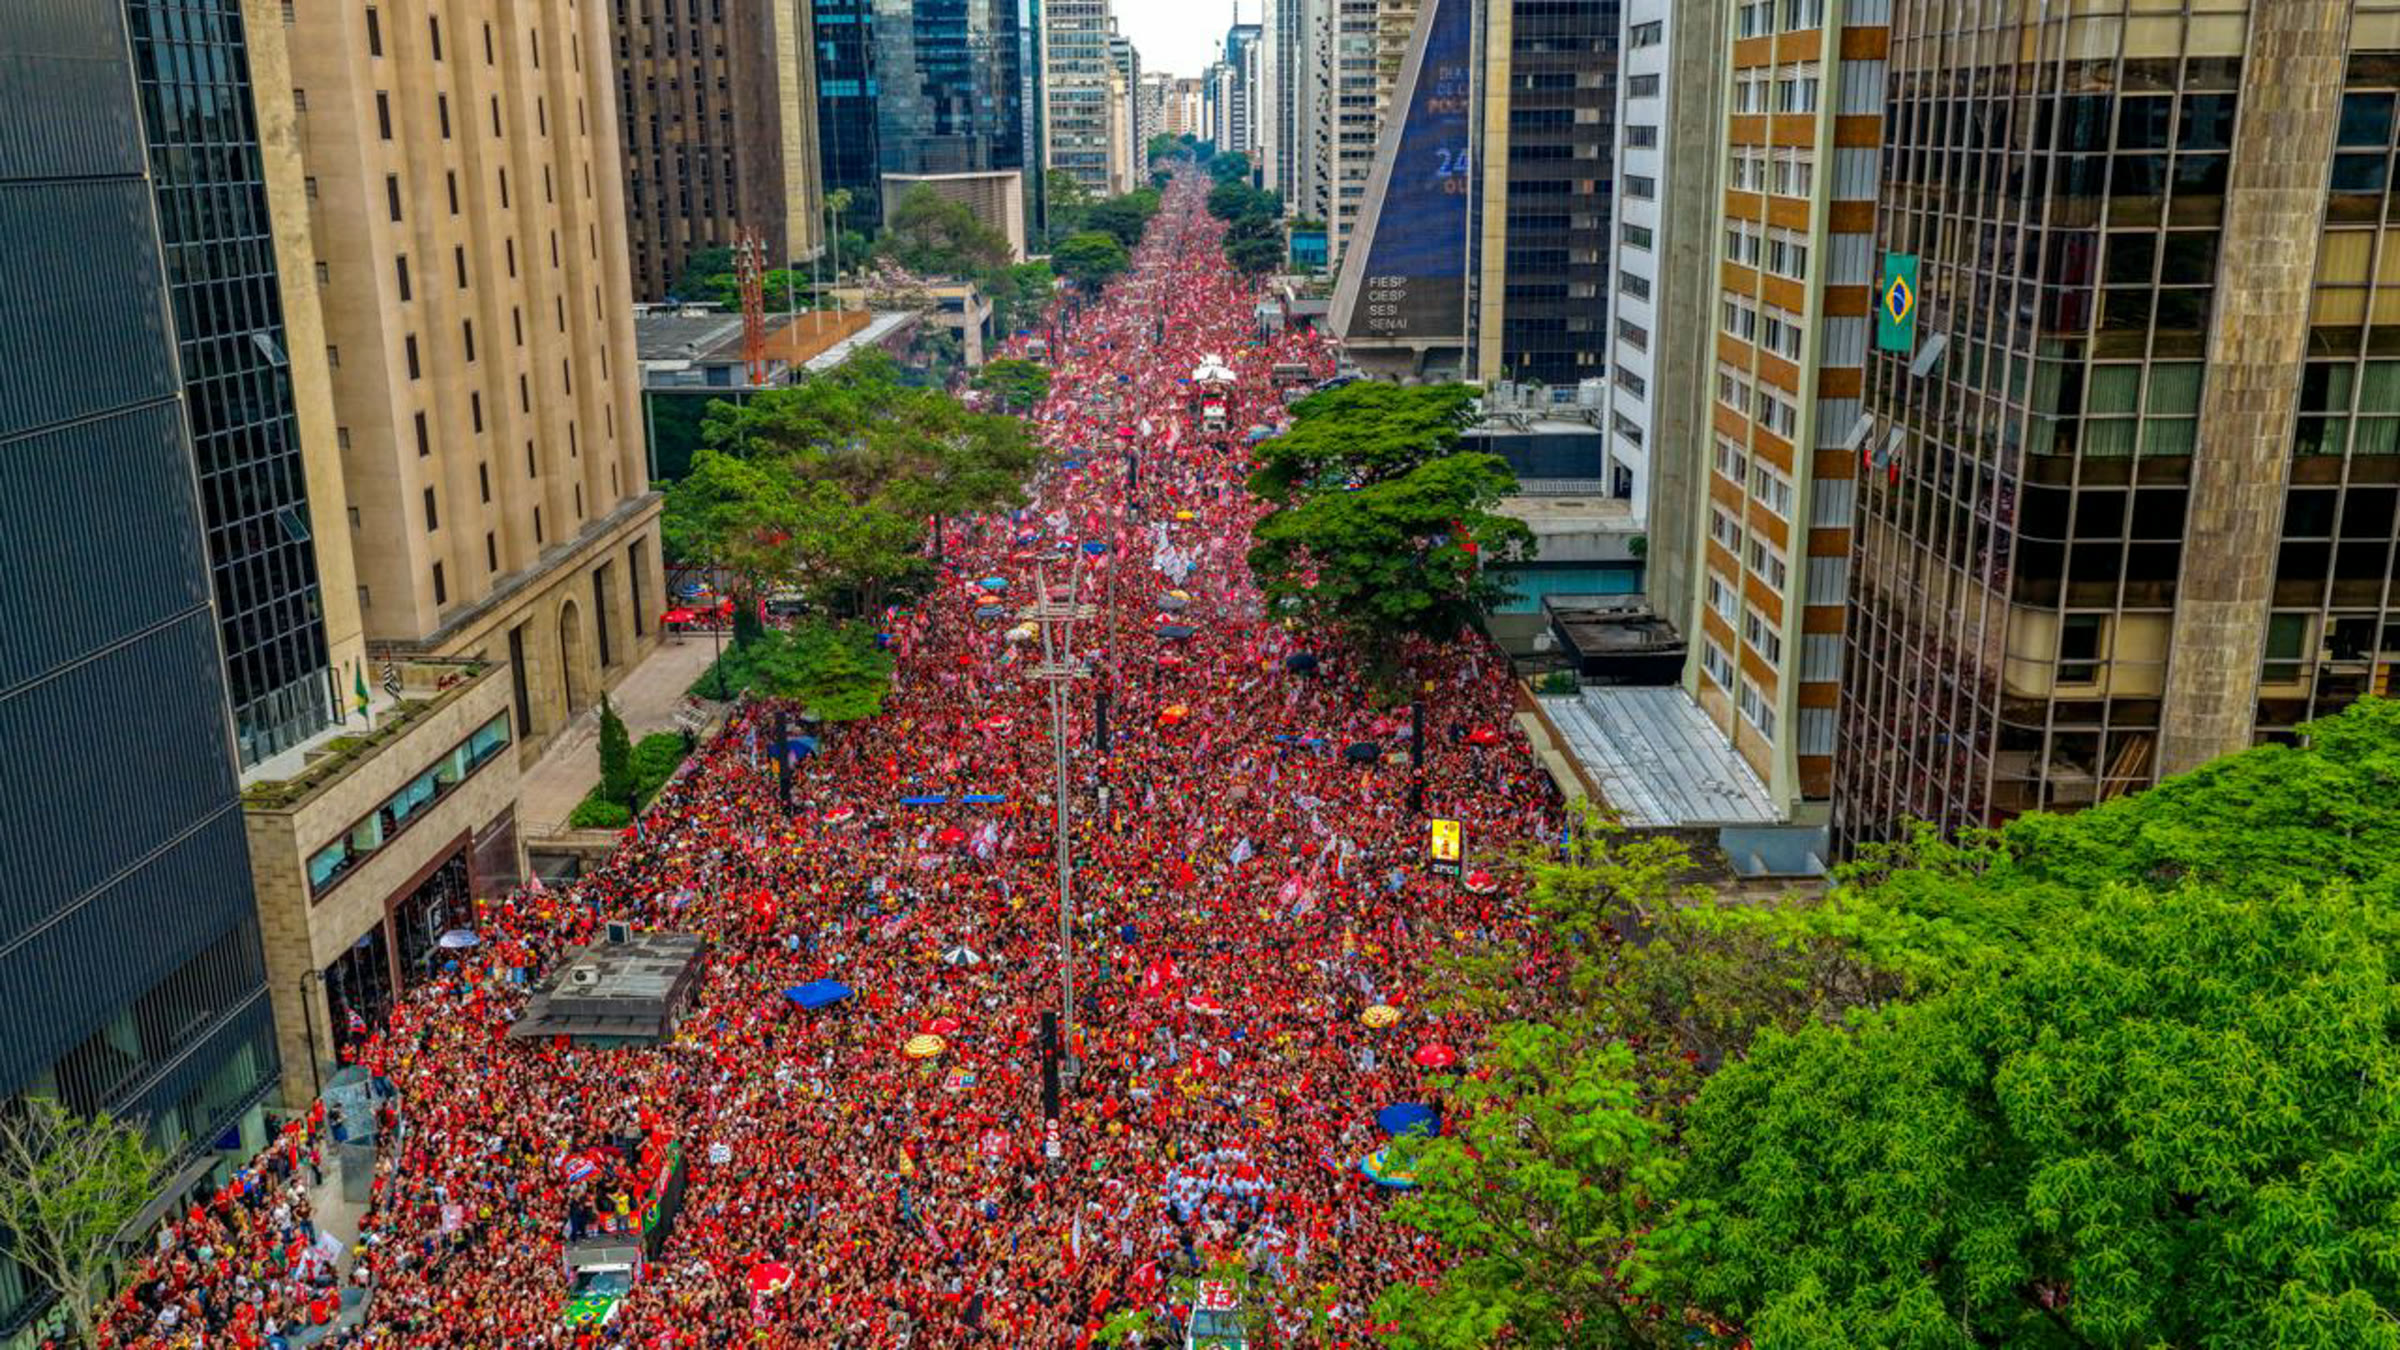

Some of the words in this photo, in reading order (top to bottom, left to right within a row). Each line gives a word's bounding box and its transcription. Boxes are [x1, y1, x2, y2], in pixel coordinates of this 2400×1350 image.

[1370, 276, 1407, 288] FIESP
[1368, 289, 1406, 301] CIESP
[1370, 304, 1397, 316] SESI
[1370, 318, 1407, 329] SENAI
